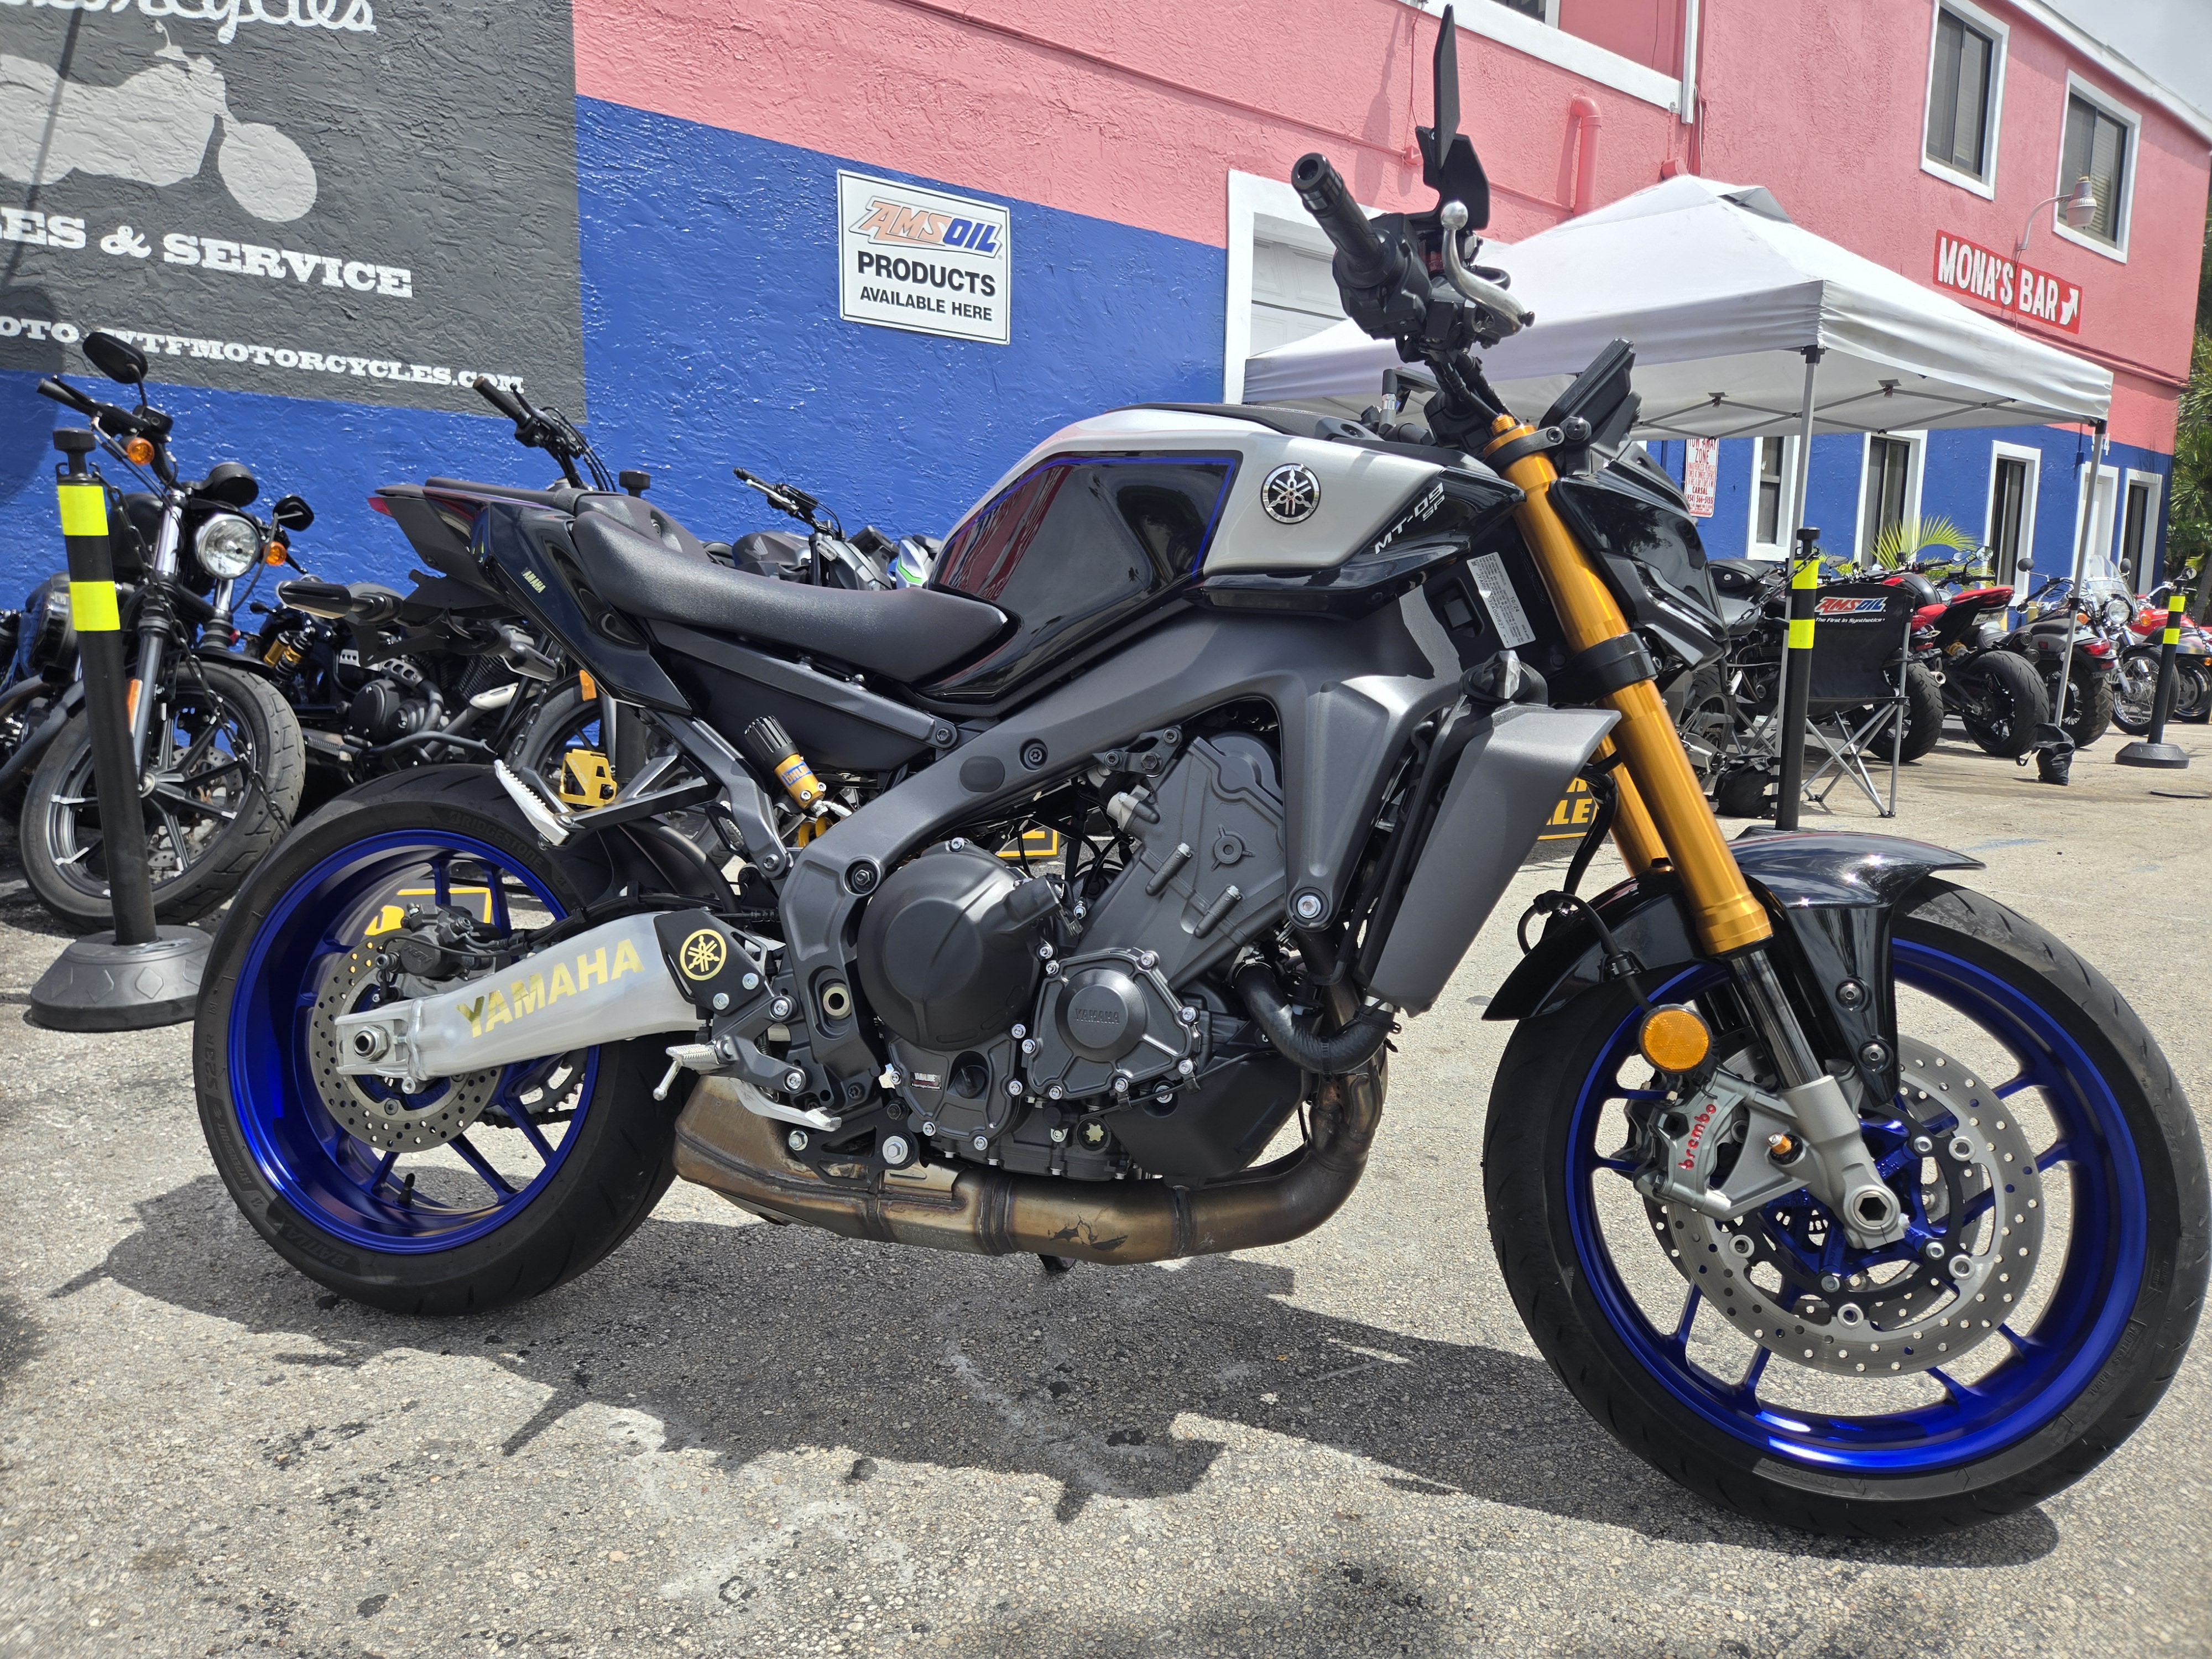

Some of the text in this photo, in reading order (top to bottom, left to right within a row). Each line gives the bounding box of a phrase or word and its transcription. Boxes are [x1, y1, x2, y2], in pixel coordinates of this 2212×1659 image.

[855, 198, 1000, 255] AMSOIL
[0, 207, 413, 298] ES & SERVICE
[857, 250, 997, 298] PRODUCTS
[1937, 236, 2059, 322] MONA'S BAR
[860, 286, 993, 322] AVAILABLE HERE
[1695, 448, 1709, 465] ZONE
[1422, 494, 1446, 522] SP
[1692, 486, 1708, 495] CARSAL
[1375, 482, 1444, 555] MT-09
[1510, 596, 1520, 613] 10/24
[1815, 597, 1887, 615] AMSOIL
[1546, 798, 1593, 826] LE
[447, 810, 546, 867] BRIDGESTONE
[455, 938, 645, 1039] YAMAHA
[1074, 1008, 1121, 1026] YAMAHA
[216, 1121, 253, 1186] HYPERSPORT
[1678, 1103, 1717, 1170] brembo
[1757, 1458, 1839, 1490] BRIDGESTO
